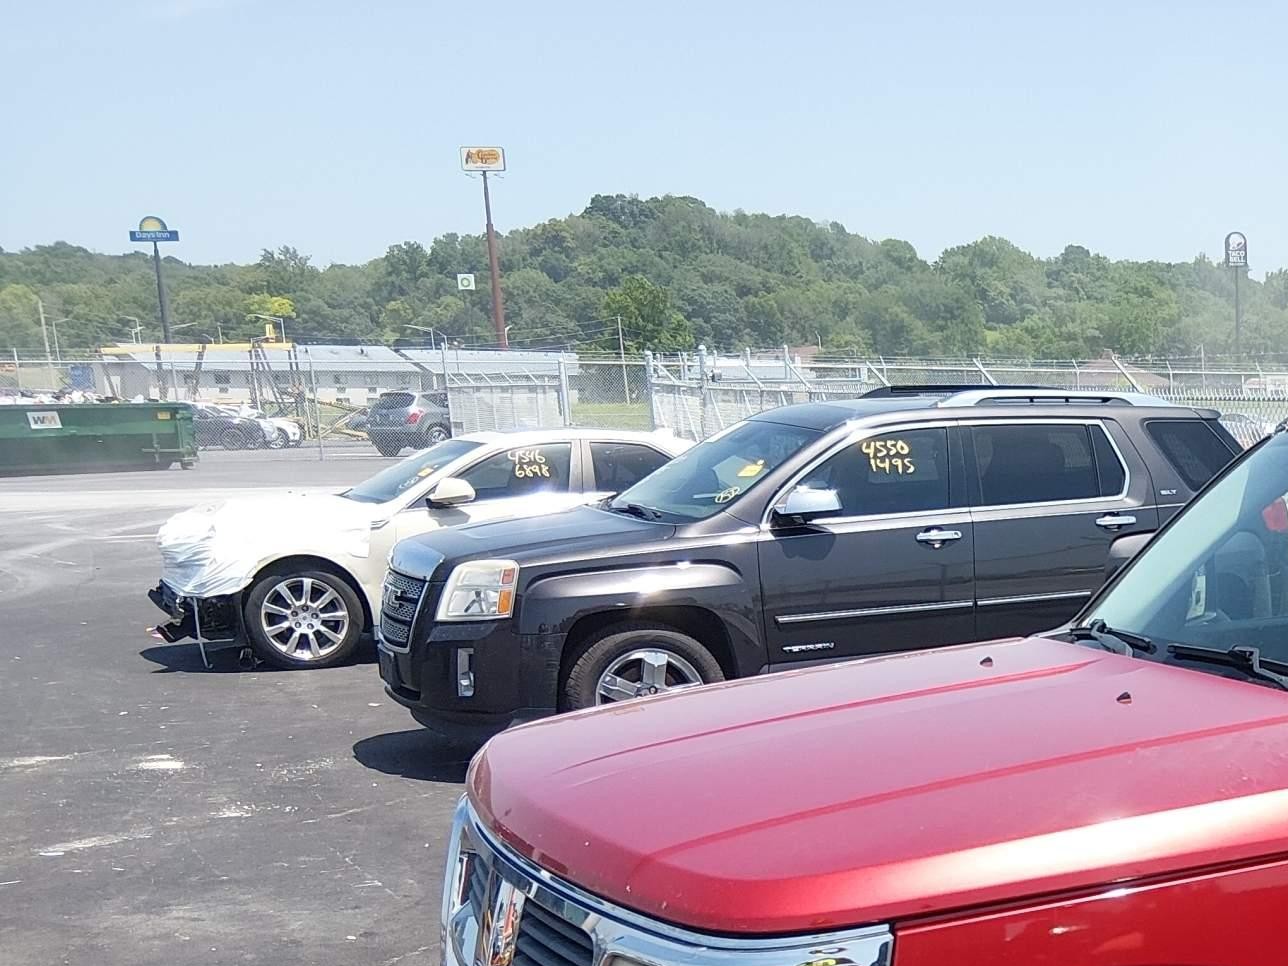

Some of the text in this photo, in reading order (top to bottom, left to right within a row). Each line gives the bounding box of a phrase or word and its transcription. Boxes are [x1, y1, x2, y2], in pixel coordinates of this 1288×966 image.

[135, 231, 170, 240] Days Inn
[32, 415, 57, 425] WM
[861, 439, 910, 458] 4550
[507, 449, 546, 464] 4546
[515, 464, 550, 478] 6898
[870, 458, 915, 475] 1495
[782, 642, 835, 653] TERRAIN
